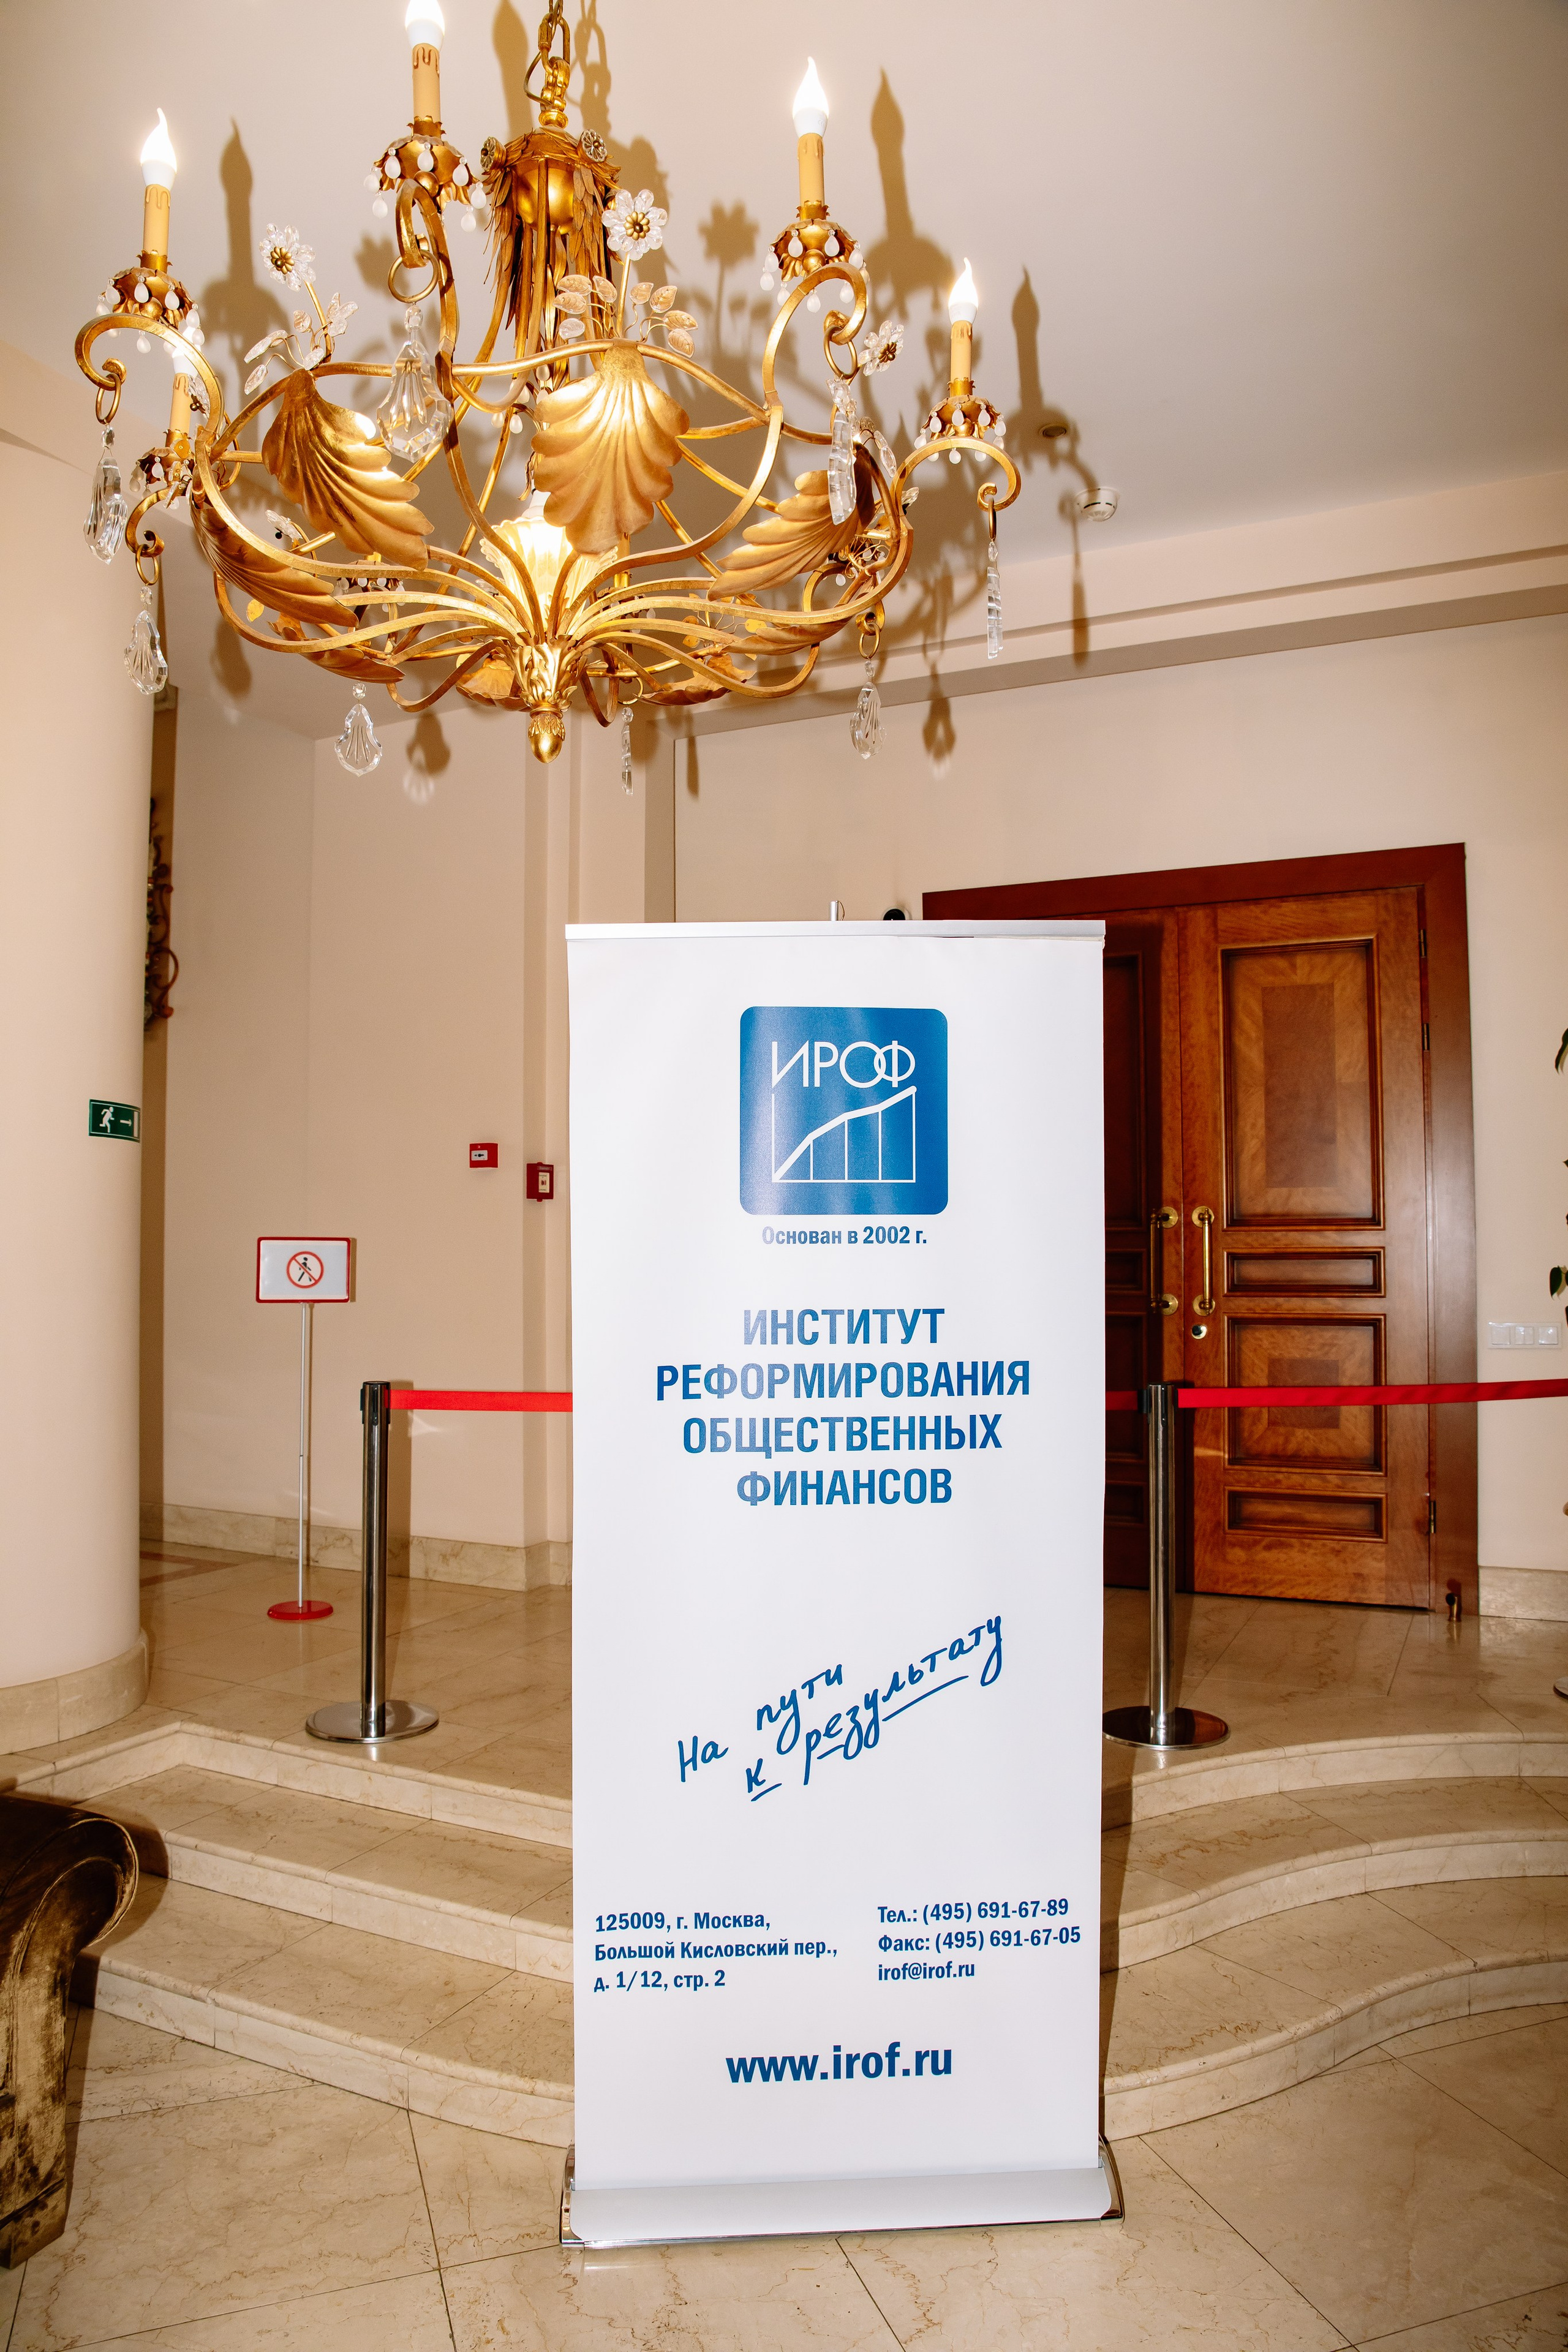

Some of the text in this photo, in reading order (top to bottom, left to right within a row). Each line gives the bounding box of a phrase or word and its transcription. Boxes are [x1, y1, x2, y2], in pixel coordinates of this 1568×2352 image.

[771, 1039, 916, 1088] ИРОФ
[761, 1225, 927, 1245] Основан в 2002 г.
[744, 1308, 946, 1345] ИНСТИТУТ
[657, 1359, 1030, 1401] РЕФОРМИРОВАНИЯ
[683, 1413, 1003, 1459] ОБЩЕСТВЕННЫХ
[737, 1468, 952, 1506] ФИНАНСОВ
[745, 1615, 1003, 1794] к результату
[677, 1664, 843, 1783] На пути
[595, 1912, 771, 1933] 125009, г. Москва,
[876, 1898, 1069, 1926] Тел.: (495) 691-67-89
[595, 1938, 837, 1961] Большой Кисловский пер.,
[878, 1926, 1082, 1953] Факс: (495) 691-67-05
[593, 1969, 726, 1993] д. 1/12, стр. 2
[878, 1960, 975, 1981] irof@irof.ru
[725, 2041, 952, 2084] www.irof.ru
